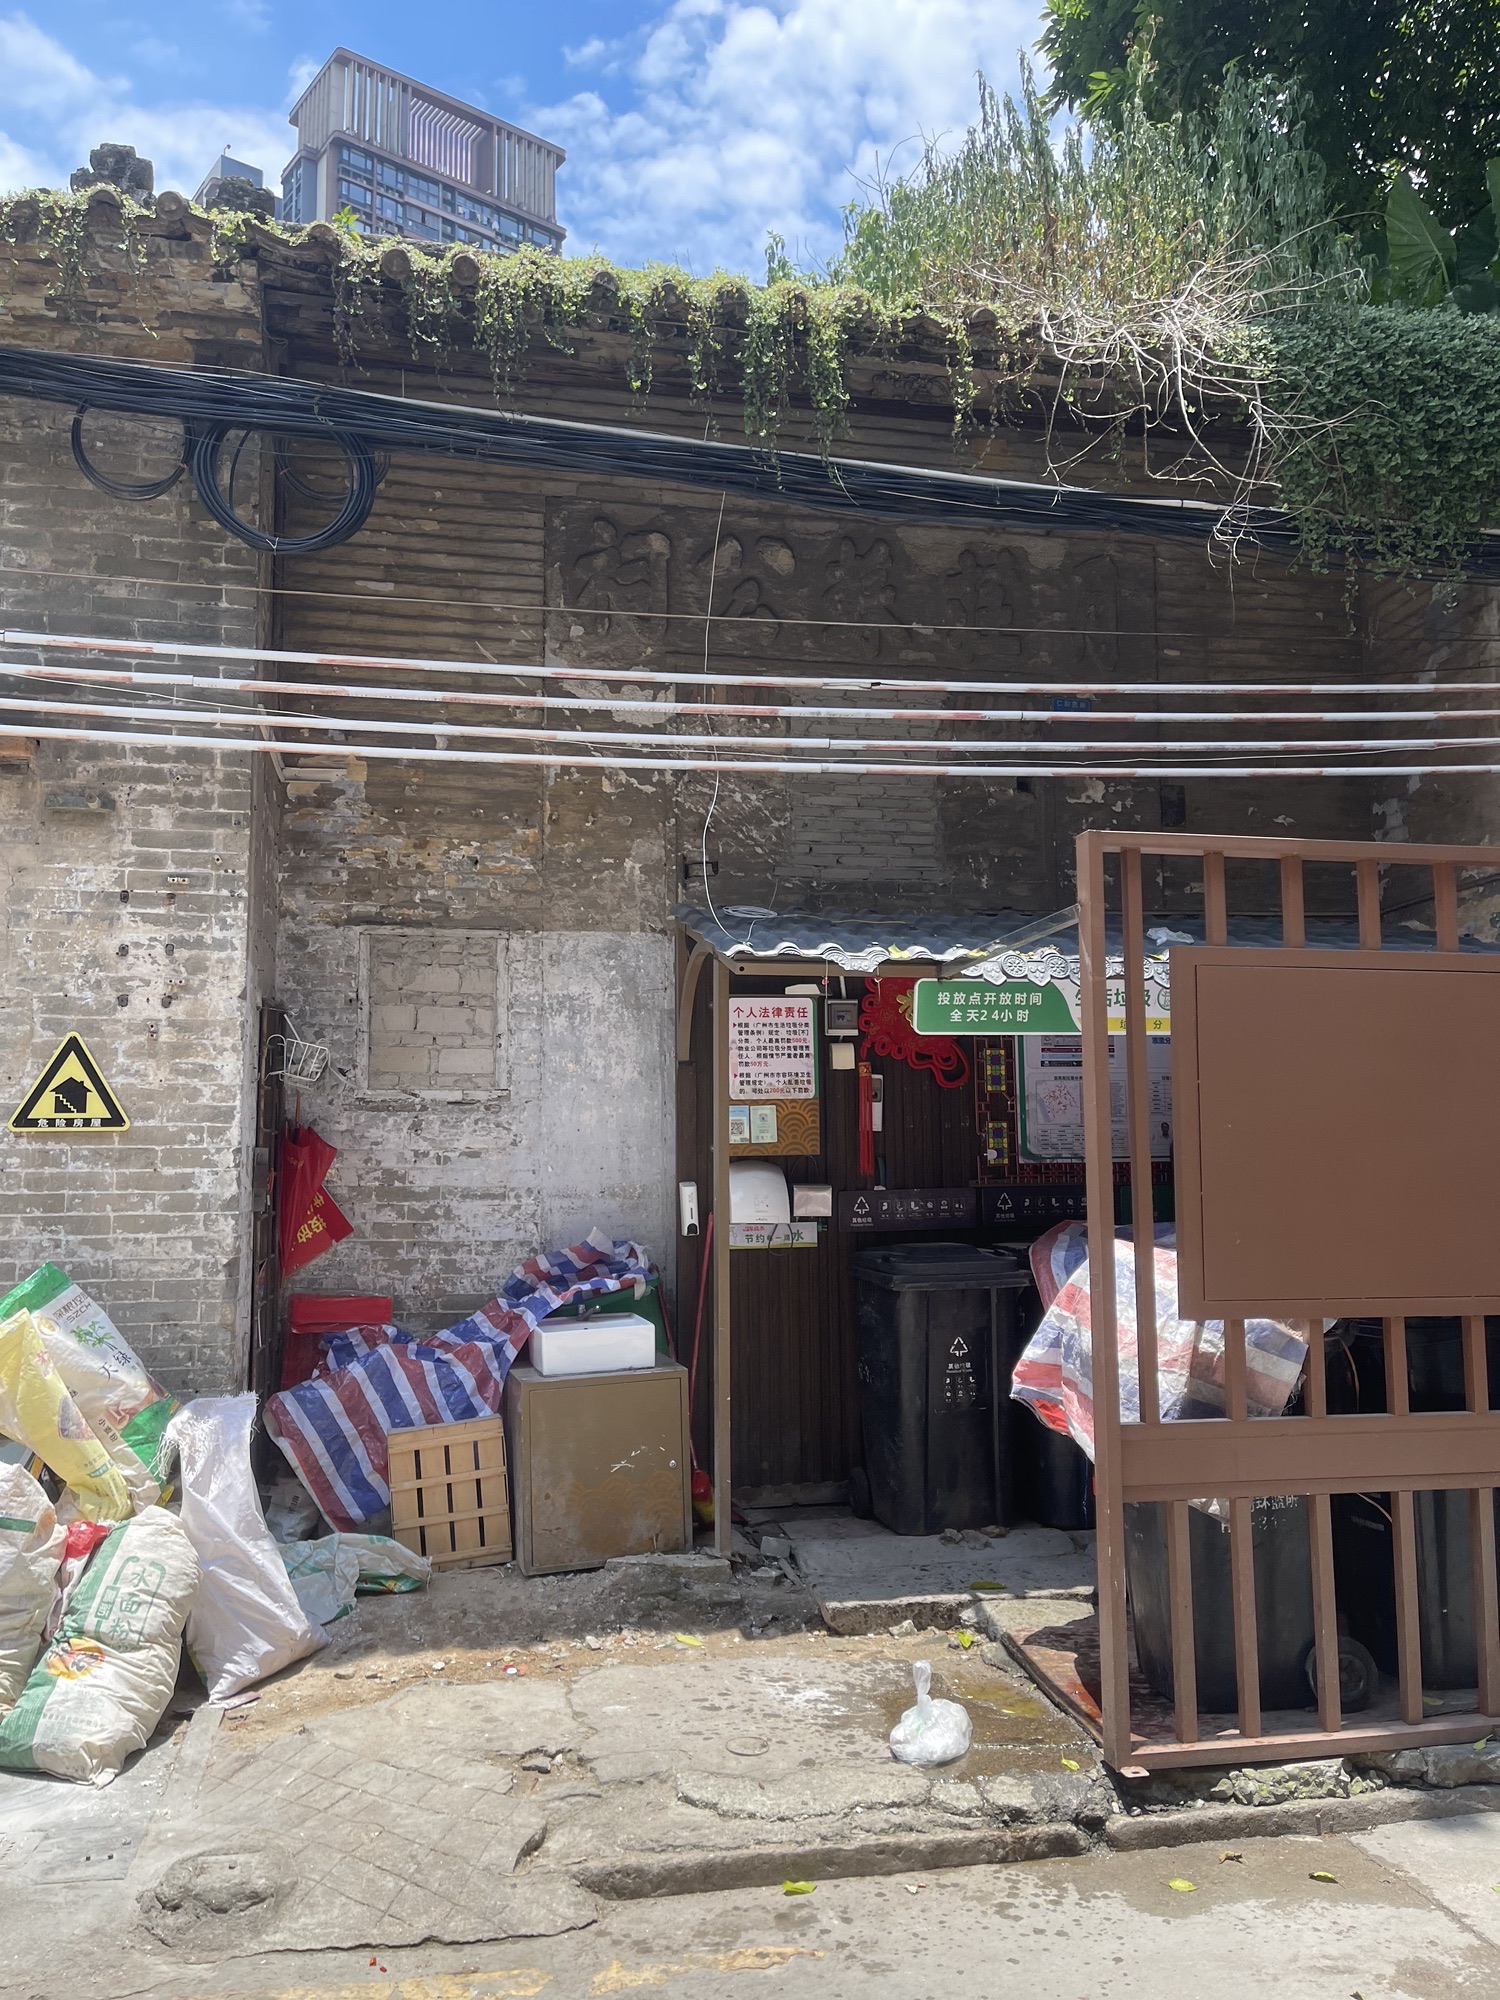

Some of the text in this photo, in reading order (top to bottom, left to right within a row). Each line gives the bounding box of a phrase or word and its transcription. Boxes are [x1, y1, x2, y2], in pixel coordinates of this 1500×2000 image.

[938, 992, 1042, 1005] 投放点开放时间
[733, 1007, 808, 1018] 个人法律责任
[950, 1009, 1029, 1022] 全天24小时
[37, 1118, 101, 1127] 危险房屋
[66, 1302, 92, 1323] SZCH
[108, 1567, 151, 1642] 水面粉
